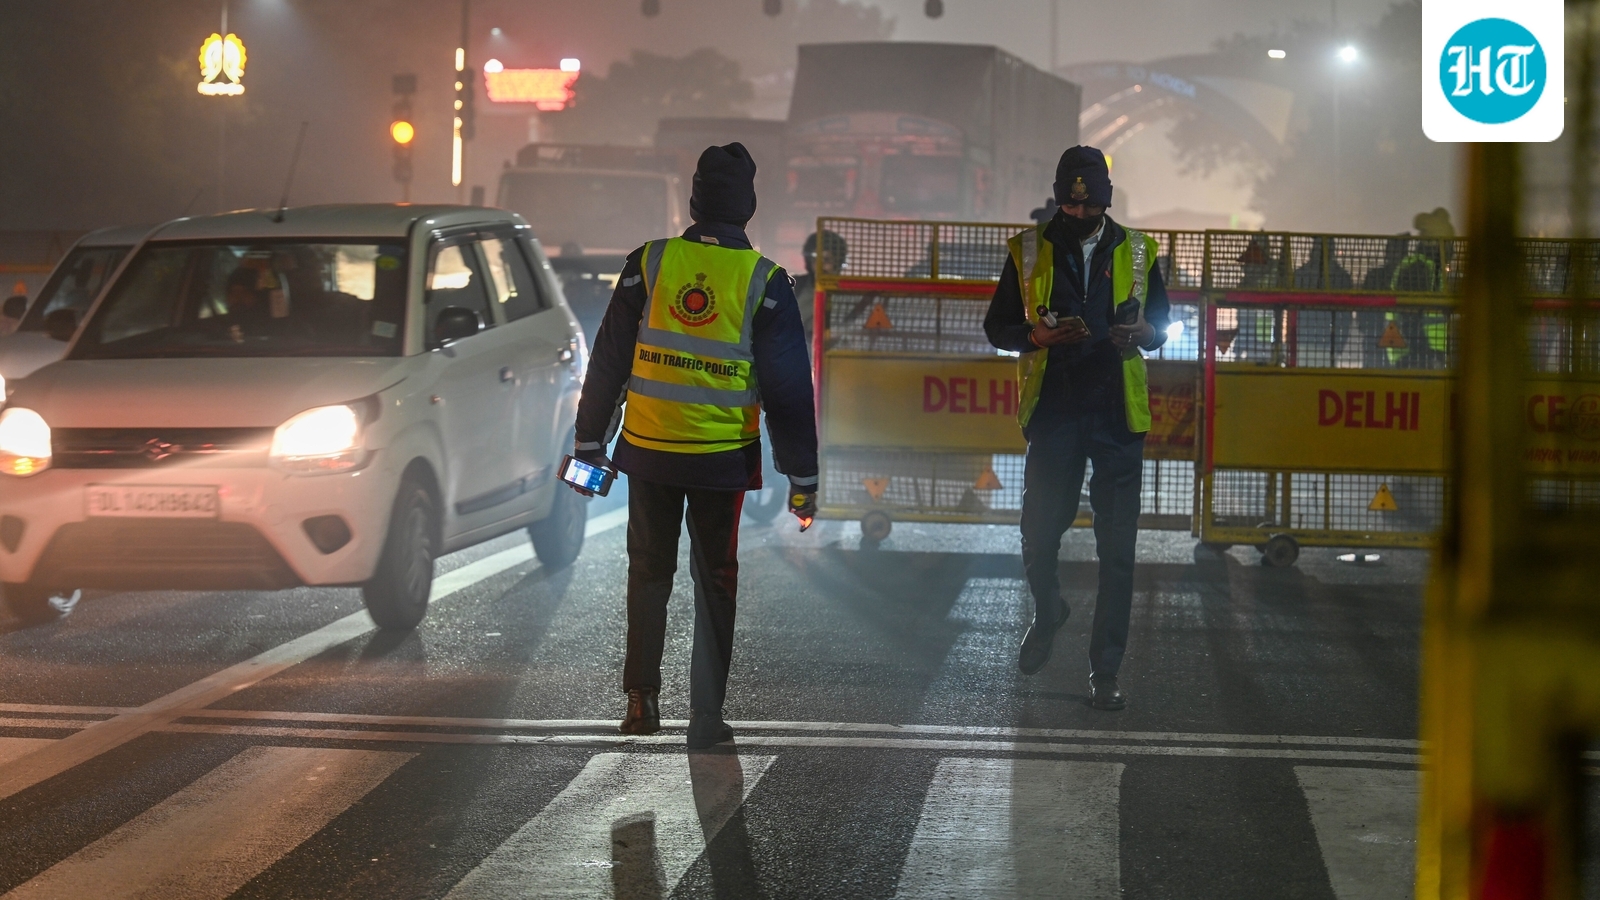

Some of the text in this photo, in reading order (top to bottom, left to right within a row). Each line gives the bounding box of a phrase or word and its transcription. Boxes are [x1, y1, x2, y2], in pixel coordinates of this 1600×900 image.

[639, 348, 739, 377] DELHI TRAFFIC POLICE
[1318, 389, 1420, 431] DELHI
